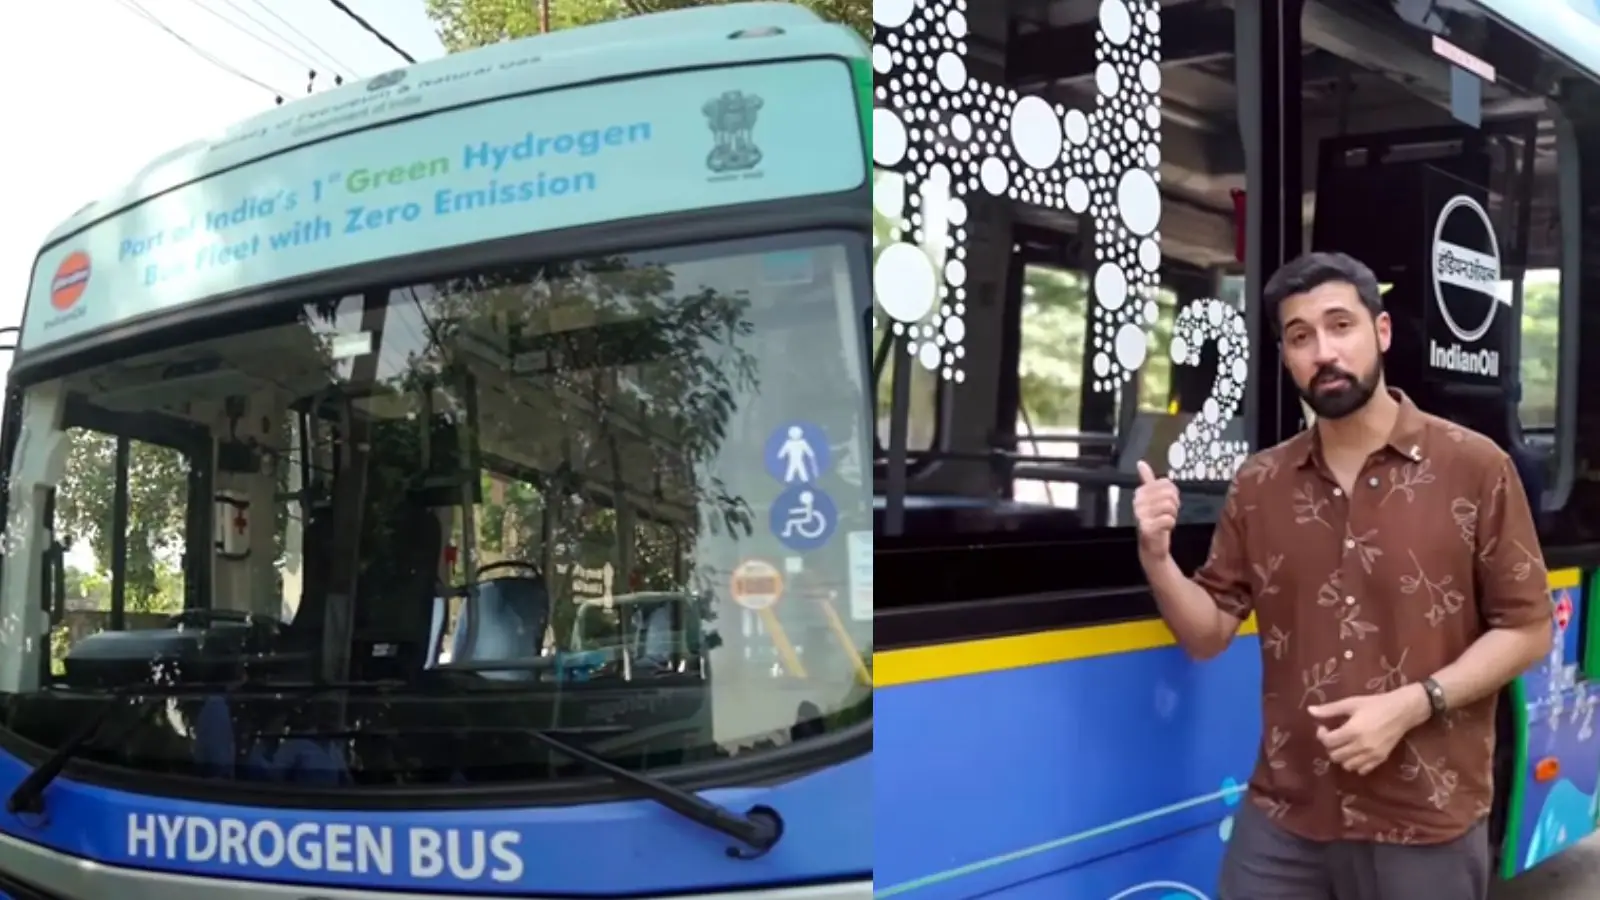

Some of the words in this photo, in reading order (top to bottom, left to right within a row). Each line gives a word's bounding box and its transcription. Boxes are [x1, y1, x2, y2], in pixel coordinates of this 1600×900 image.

[119, 230, 164, 262] Part
[345, 155, 450, 195] Green
[462, 121, 652, 171] Hydrogen
[268, 214, 333, 251] with
[343, 200, 421, 234] Zero
[433, 170, 597, 216] Emission
[1429, 338, 1500, 378] IndianOil
[126, 812, 393, 876] HYDROGEN
[408, 827, 525, 882] BUS
